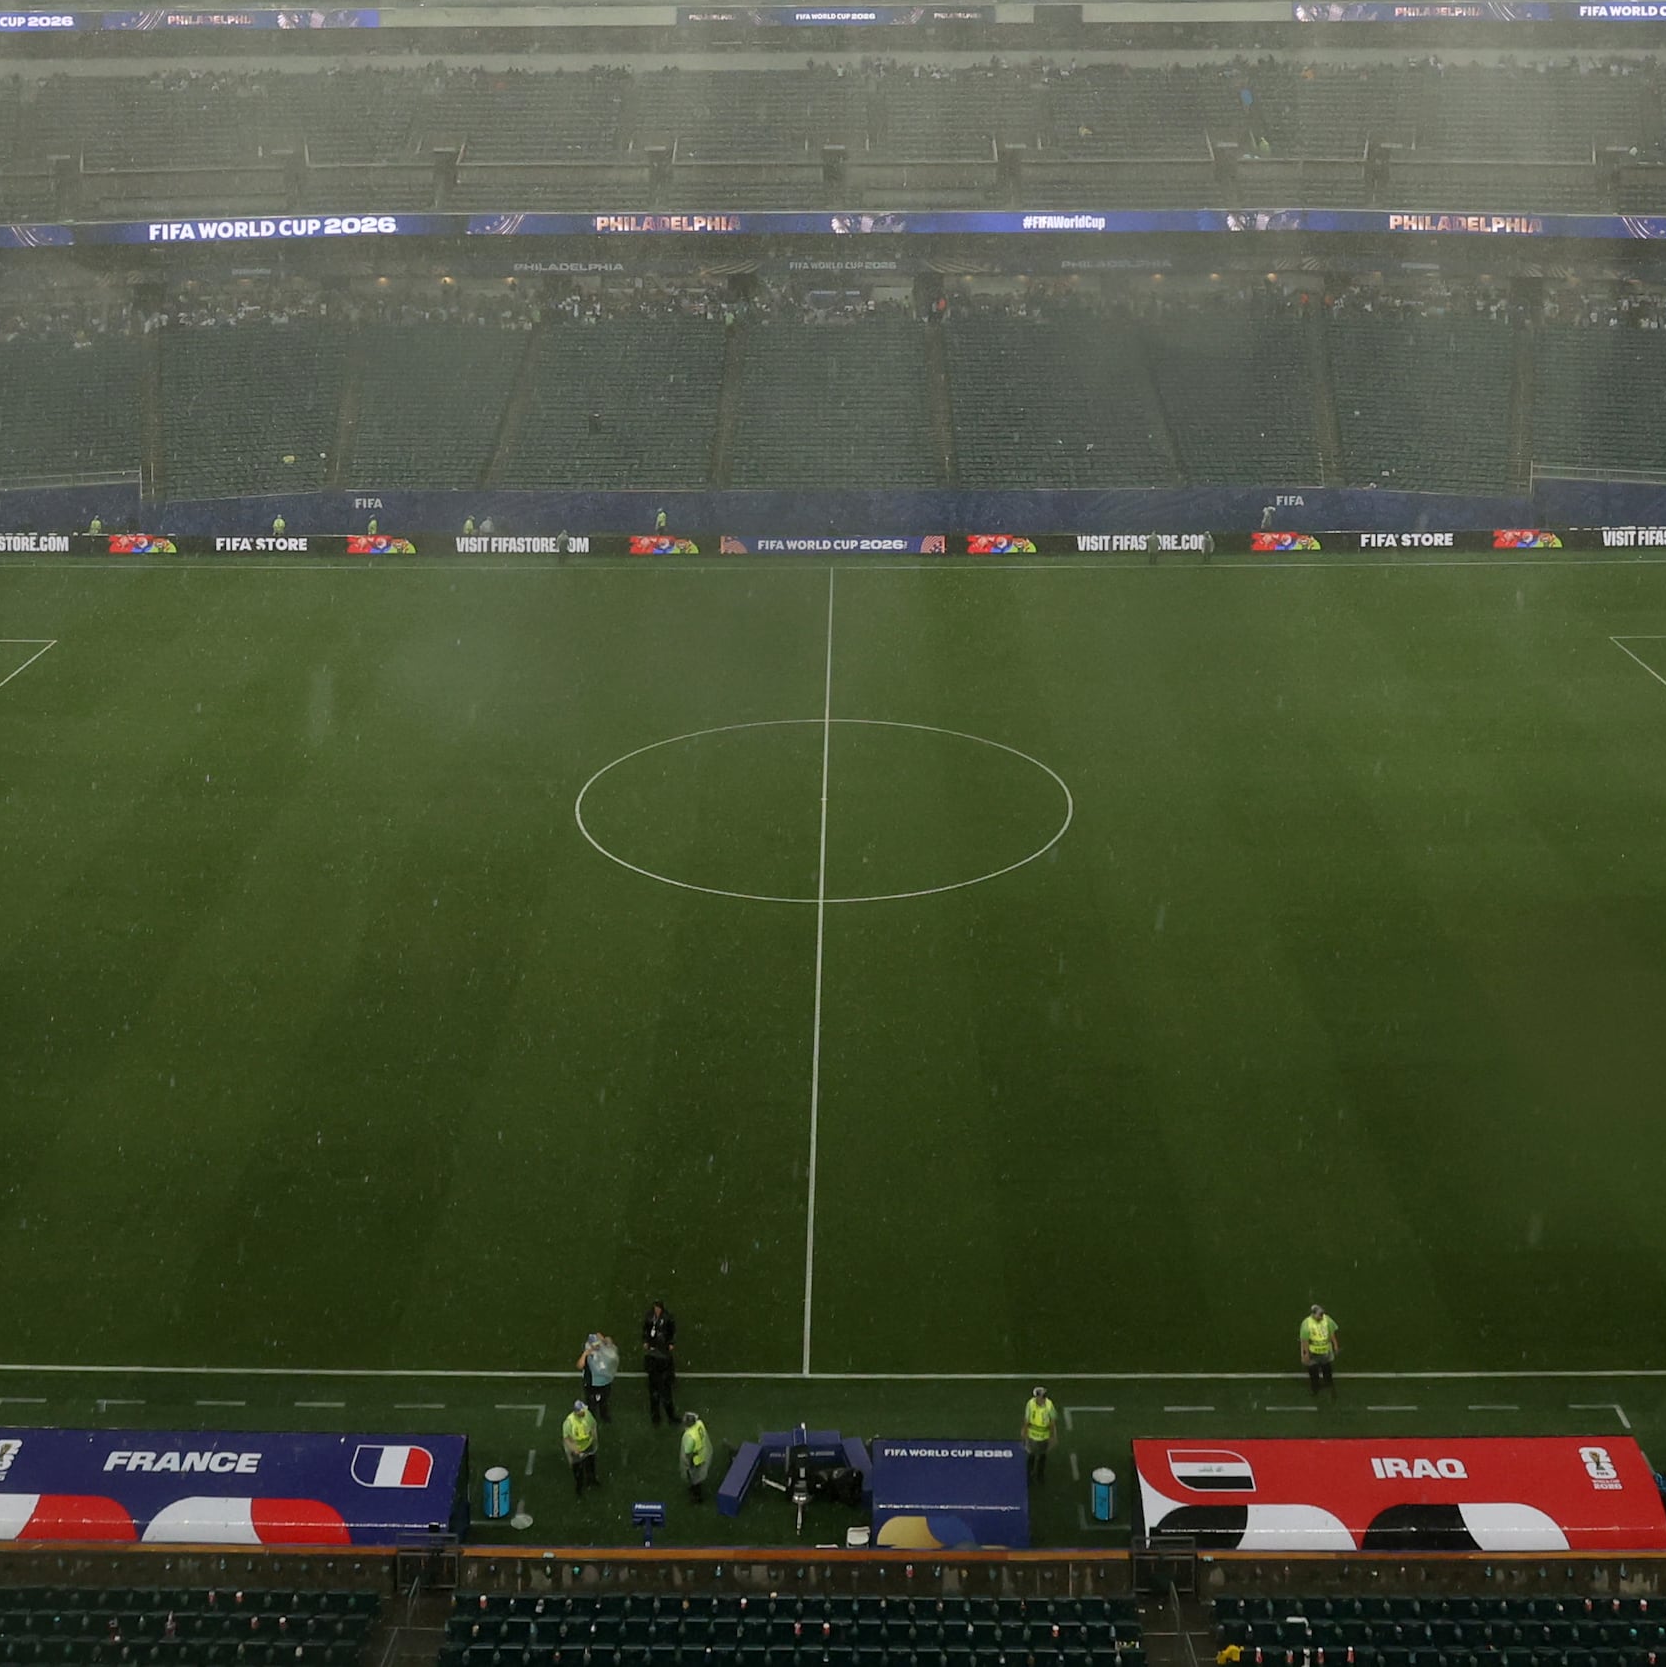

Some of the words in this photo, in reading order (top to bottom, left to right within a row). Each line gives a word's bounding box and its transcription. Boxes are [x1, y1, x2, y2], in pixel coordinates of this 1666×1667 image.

[1580, 5, 1608, 17] FIFA
[1610, 5, 1658, 17] WORLD
[0, 16, 26, 28] CUP
[27, 15, 74, 27] 2026
[149, 223, 196, 241] FIFA
[197, 220, 277, 239] WORLD
[278, 219, 321, 236] CUP
[323, 216, 397, 234] 2026
[596, 216, 741, 232] PHILADELPHIA
[1023, 215, 1106, 231] #FIFAWorldCup
[1389, 214, 1542, 234] PHILADELPHIA
[355, 498, 383, 509] FIFA
[1276, 495, 1305, 506] FIFA
[256, 538, 308, 551] STORE
[456, 537, 489, 552] VISIT
[491, 537, 589, 553] FIFASTORE.OM
[758, 540, 784, 550] FIFA
[786, 540, 831, 550] WORLD
[833, 540, 859, 550] CUP
[860, 540, 904, 550] 2026
[1077, 535, 1112, 551] VISIT
[1113, 534, 1205, 551] FIFASRE.CO
[1401, 533, 1454, 547] STORE
[1602, 530, 1636, 547] VISIT
[885, 1448, 907, 1457] FIFA
[909, 1449, 949, 1457] WORLD
[950, 1449, 973, 1457] CUP
[103, 1450, 263, 1475] FRANCE
[1372, 1457, 1468, 1479] IRAQ
